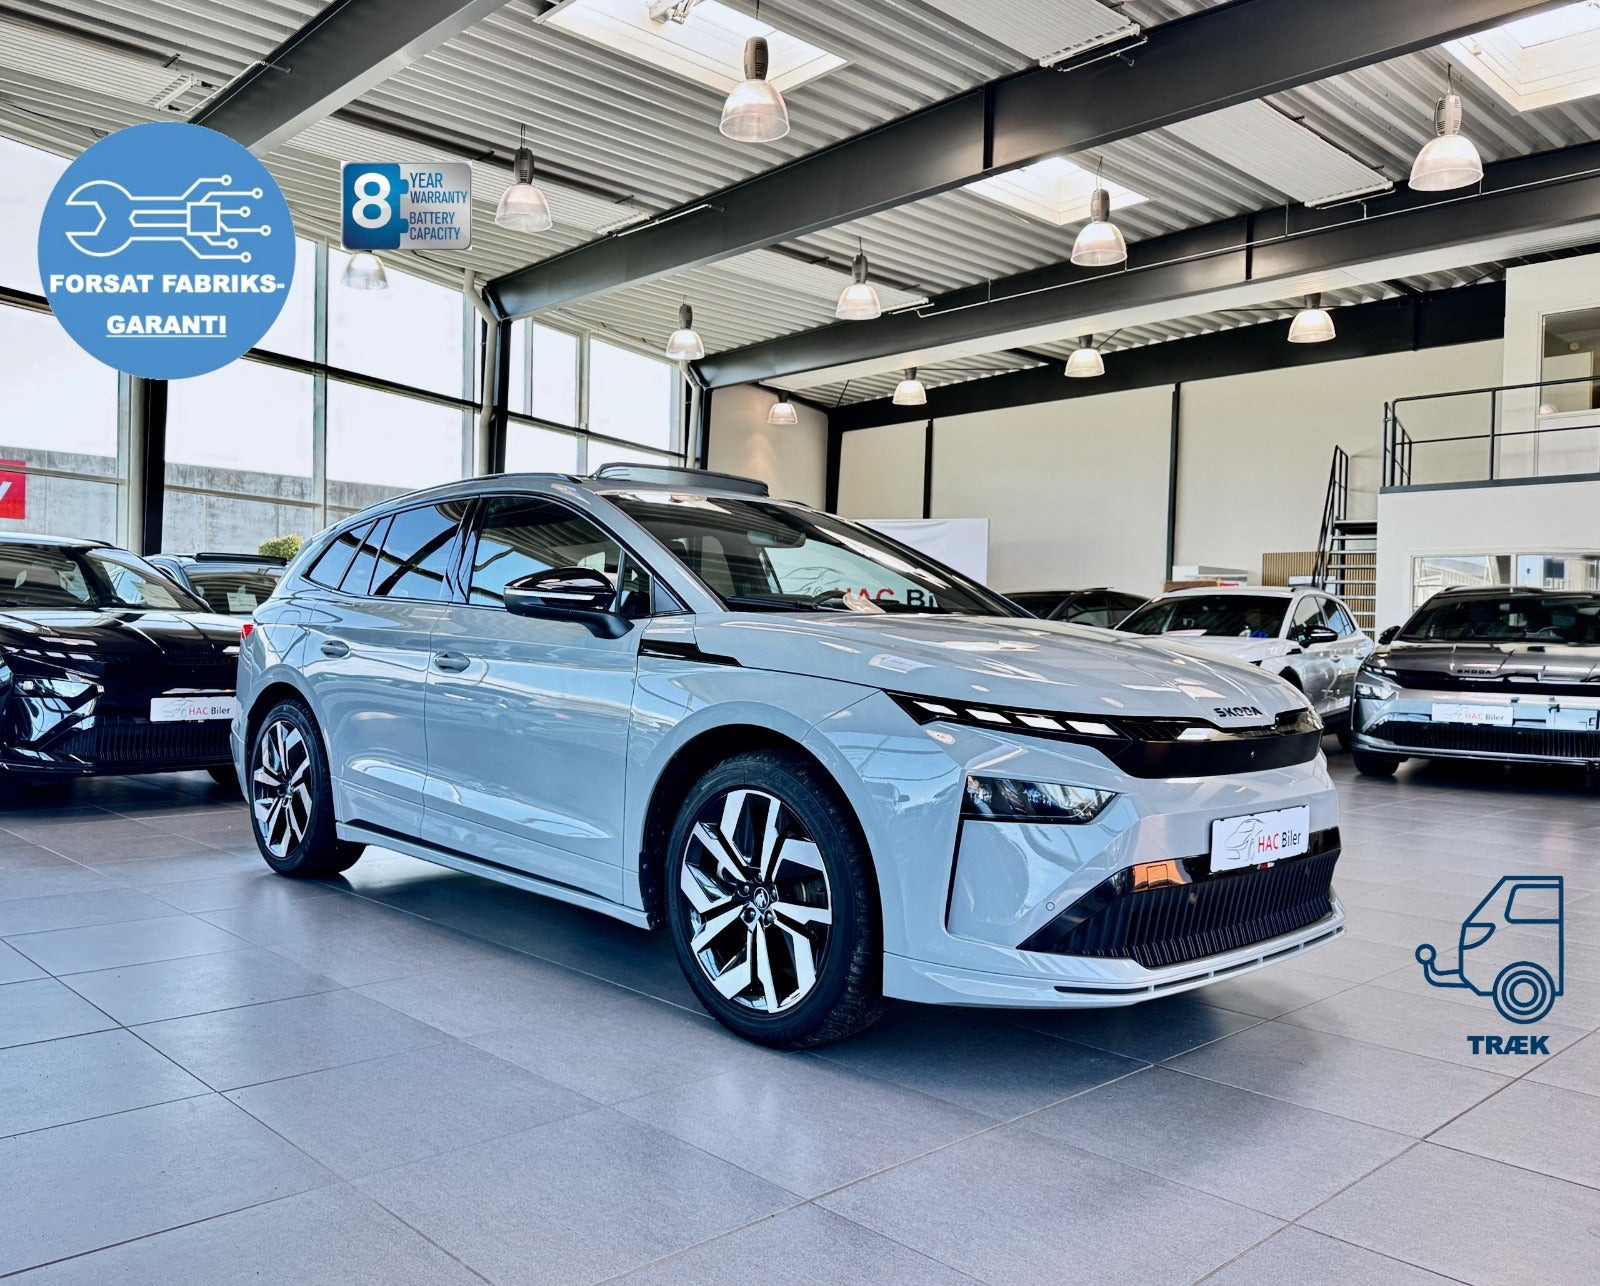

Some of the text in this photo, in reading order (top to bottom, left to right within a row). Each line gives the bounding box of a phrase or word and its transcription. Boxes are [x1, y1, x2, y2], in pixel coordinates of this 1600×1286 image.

[188, 706, 231, 716] HAC Biler
[1464, 711, 1504, 721] HAC Biler
[1257, 829, 1302, 853] HAC Biler
